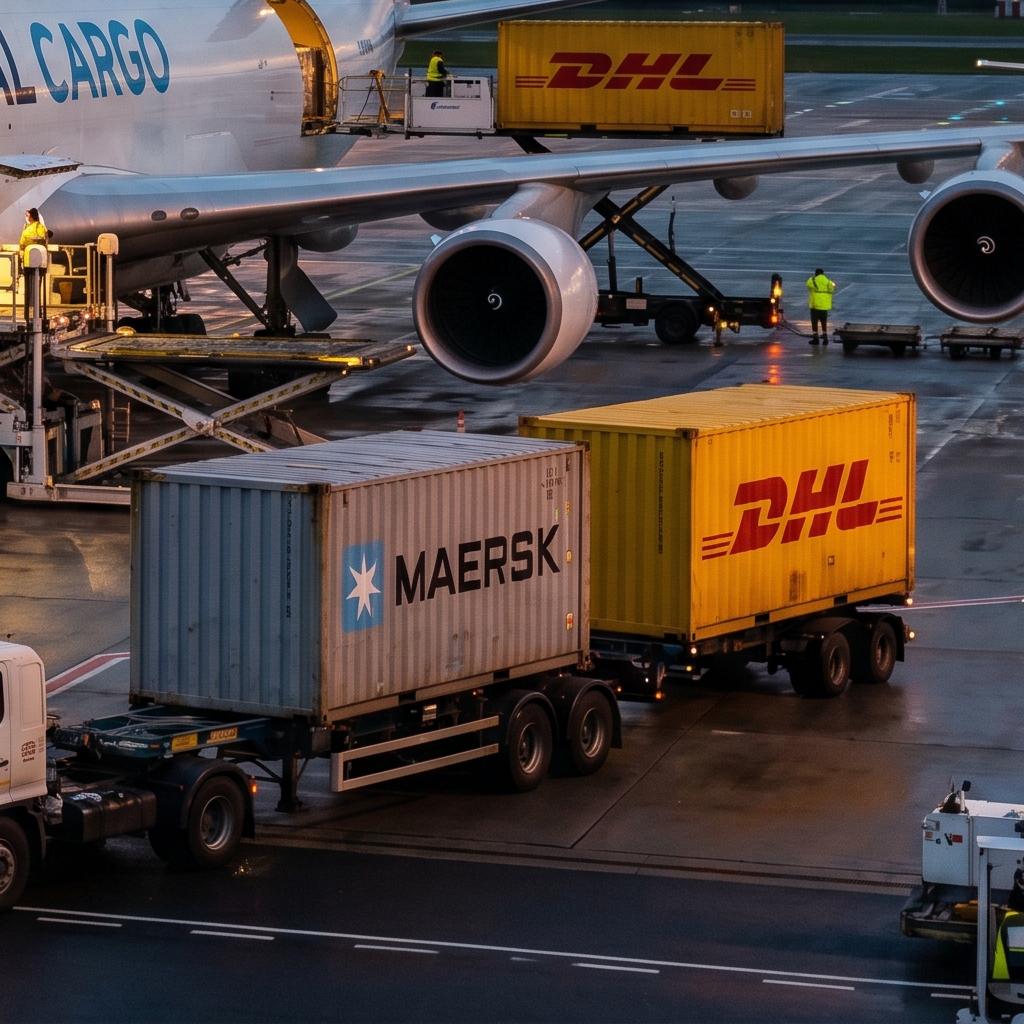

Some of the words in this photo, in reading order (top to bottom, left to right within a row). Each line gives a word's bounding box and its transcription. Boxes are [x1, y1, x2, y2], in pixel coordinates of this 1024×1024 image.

[30, 19, 170, 103] CARGO
[546, 52, 723, 90] DHL
[730, 460, 879, 556] DHL
[396, 525, 561, 606] MAERSK
